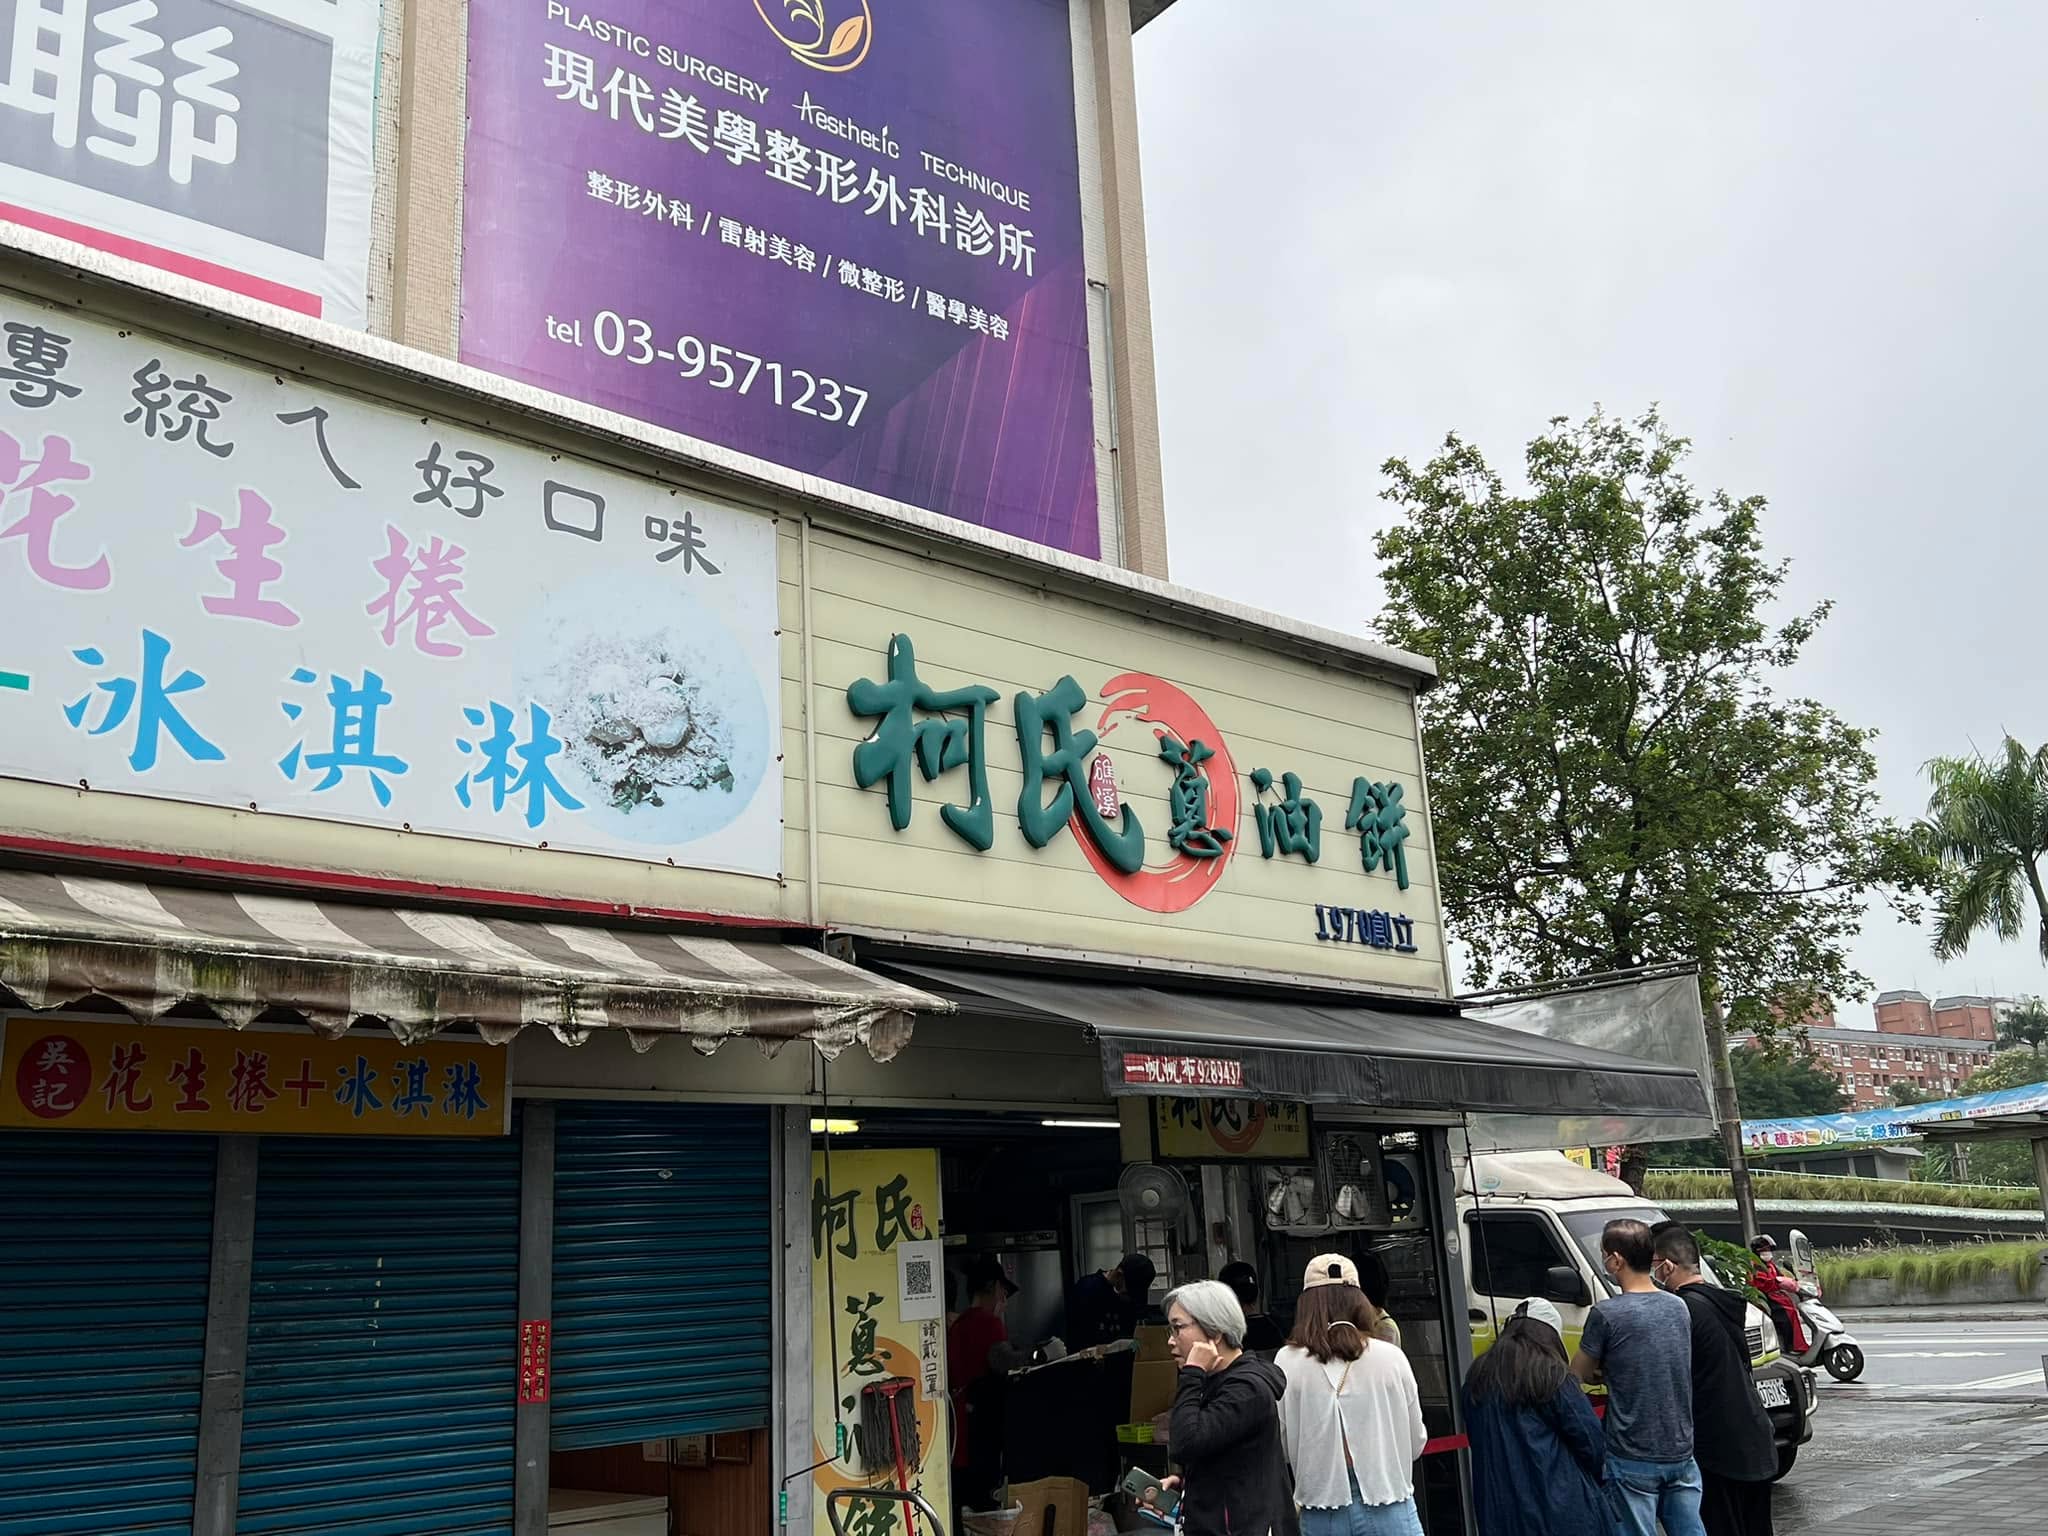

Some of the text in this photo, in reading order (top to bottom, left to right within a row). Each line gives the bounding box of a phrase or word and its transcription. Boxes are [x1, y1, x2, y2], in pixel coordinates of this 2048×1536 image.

[547, 1, 769, 104] PLASTIC SURGERY
[543, 42, 1037, 277] 現代美學整形外科診所
[792, 91, 1031, 212] Aesthetic TECHNIQUE
[586, 170, 695, 231] 整形外科
[718, 216, 817, 273] 雷射美容
[838, 258, 905, 303] 微整形
[925, 289, 1010, 341] 醫學美容
[546, 311, 868, 428] tel 03-9571237
[0, 430, 495, 657] 花生捲
[63, 628, 585, 828] 冰淇淋
[1314, 903, 1418, 953] 1970創立
[32, 1041, 75, 1111] 吳記
